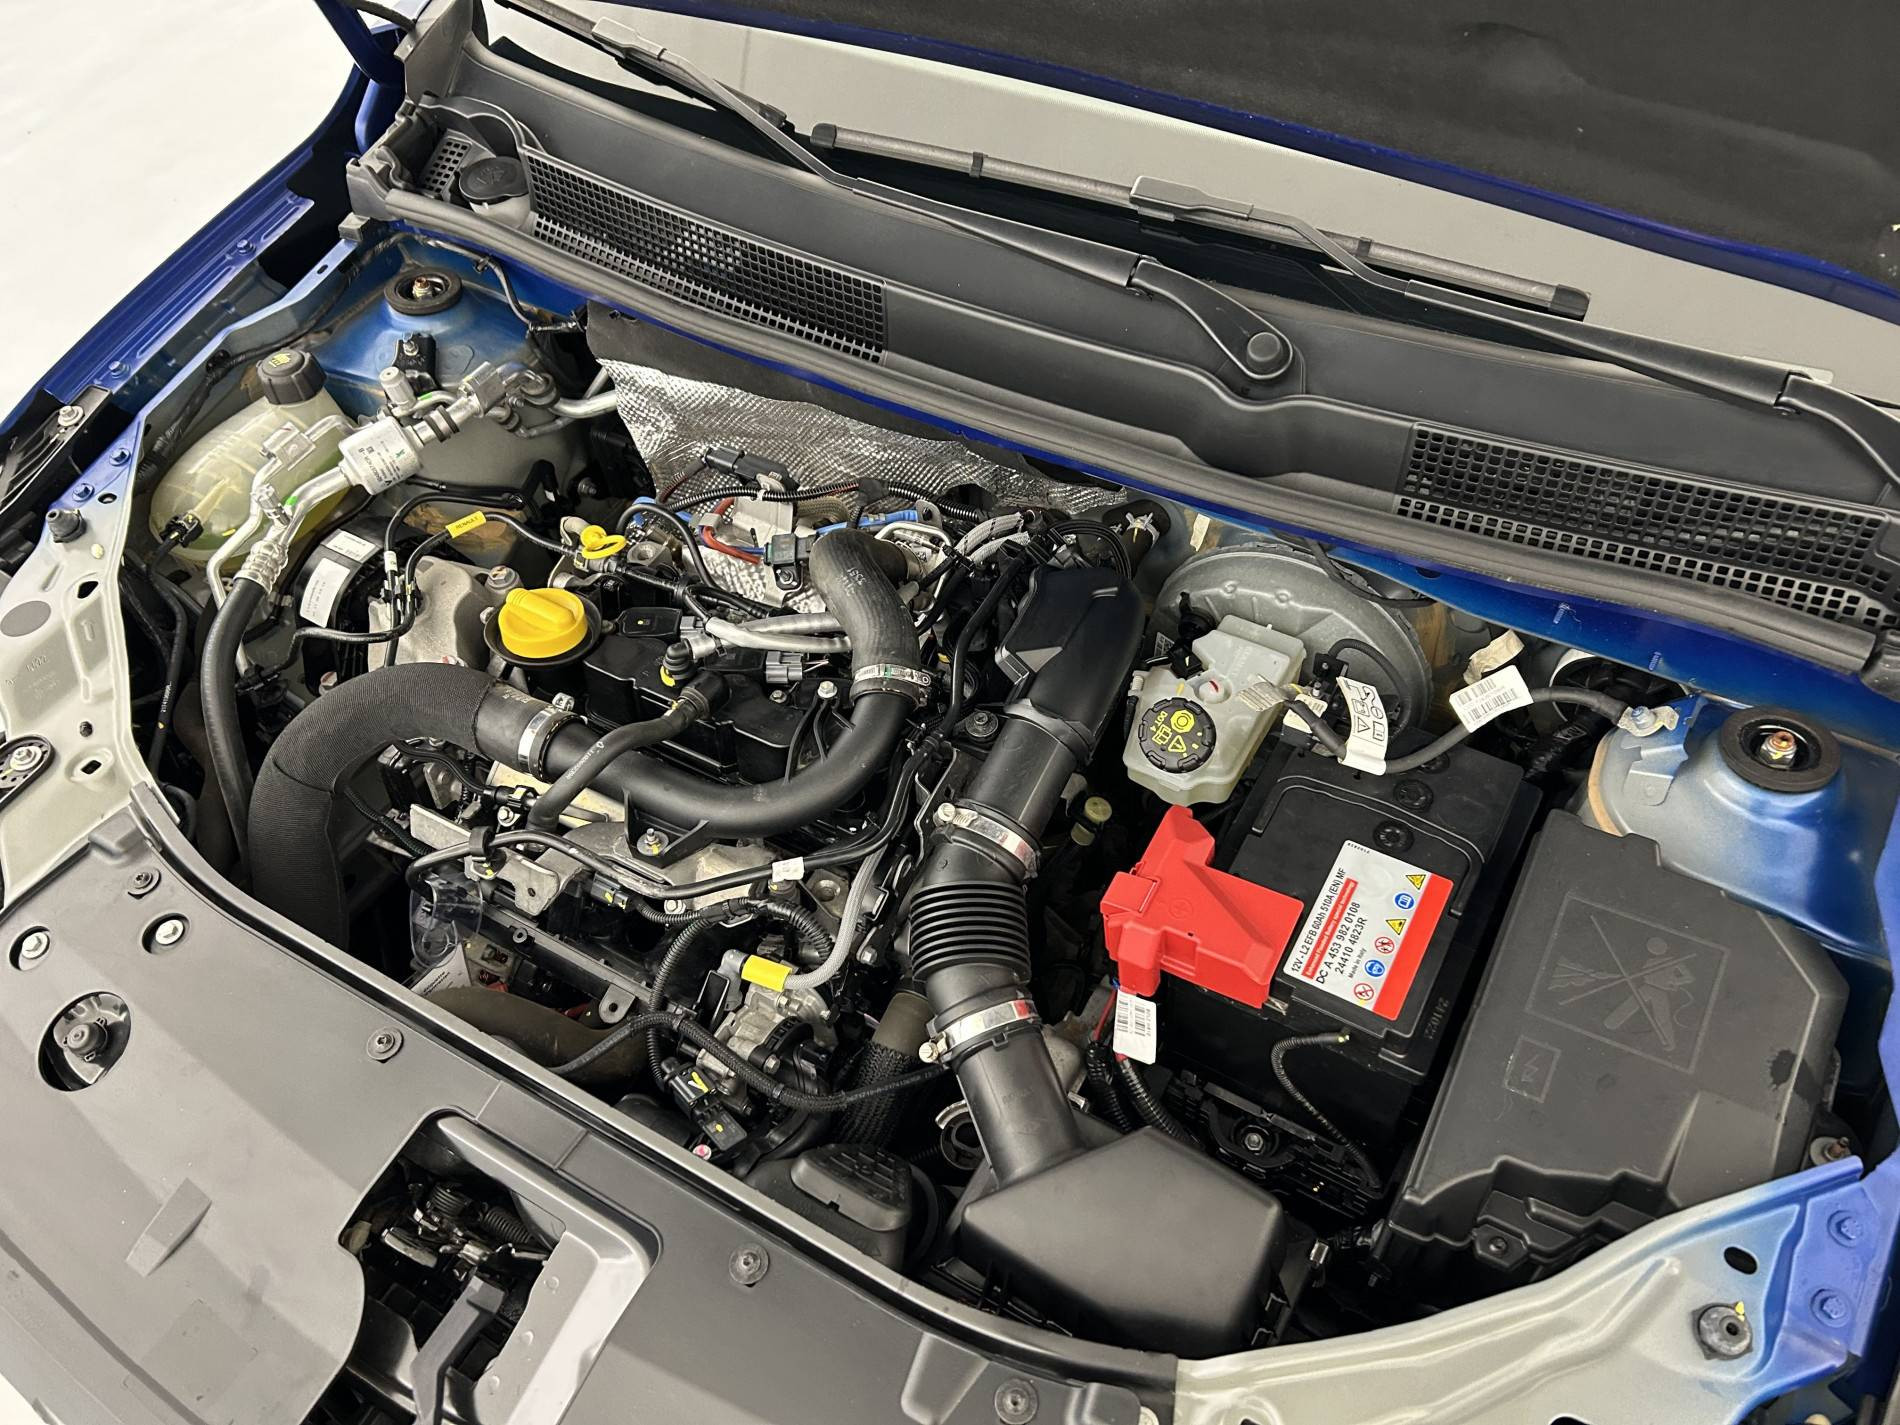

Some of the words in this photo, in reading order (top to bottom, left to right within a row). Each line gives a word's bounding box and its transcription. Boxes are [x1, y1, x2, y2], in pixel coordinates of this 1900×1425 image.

[1155, 711, 1168, 726] DOT
[1336, 868, 1345, 879] MF
[1328, 880, 1343, 895] (EN)
[1320, 895, 1335, 912] 510A
[1312, 912, 1326, 929] 60Ah
[1304, 930, 1317, 945] EFB
[1316, 970, 1328, 984] DC
[1328, 942, 1341, 959] 453
[1336, 924, 1350, 941] 982
[1344, 902, 1360, 923] 0108
[1299, 945, 1310, 955] L2
[1335, 947, 1353, 974] 24410
[1348, 917, 1367, 945] 4823R
[1291, 958, 1303, 972] 12V
